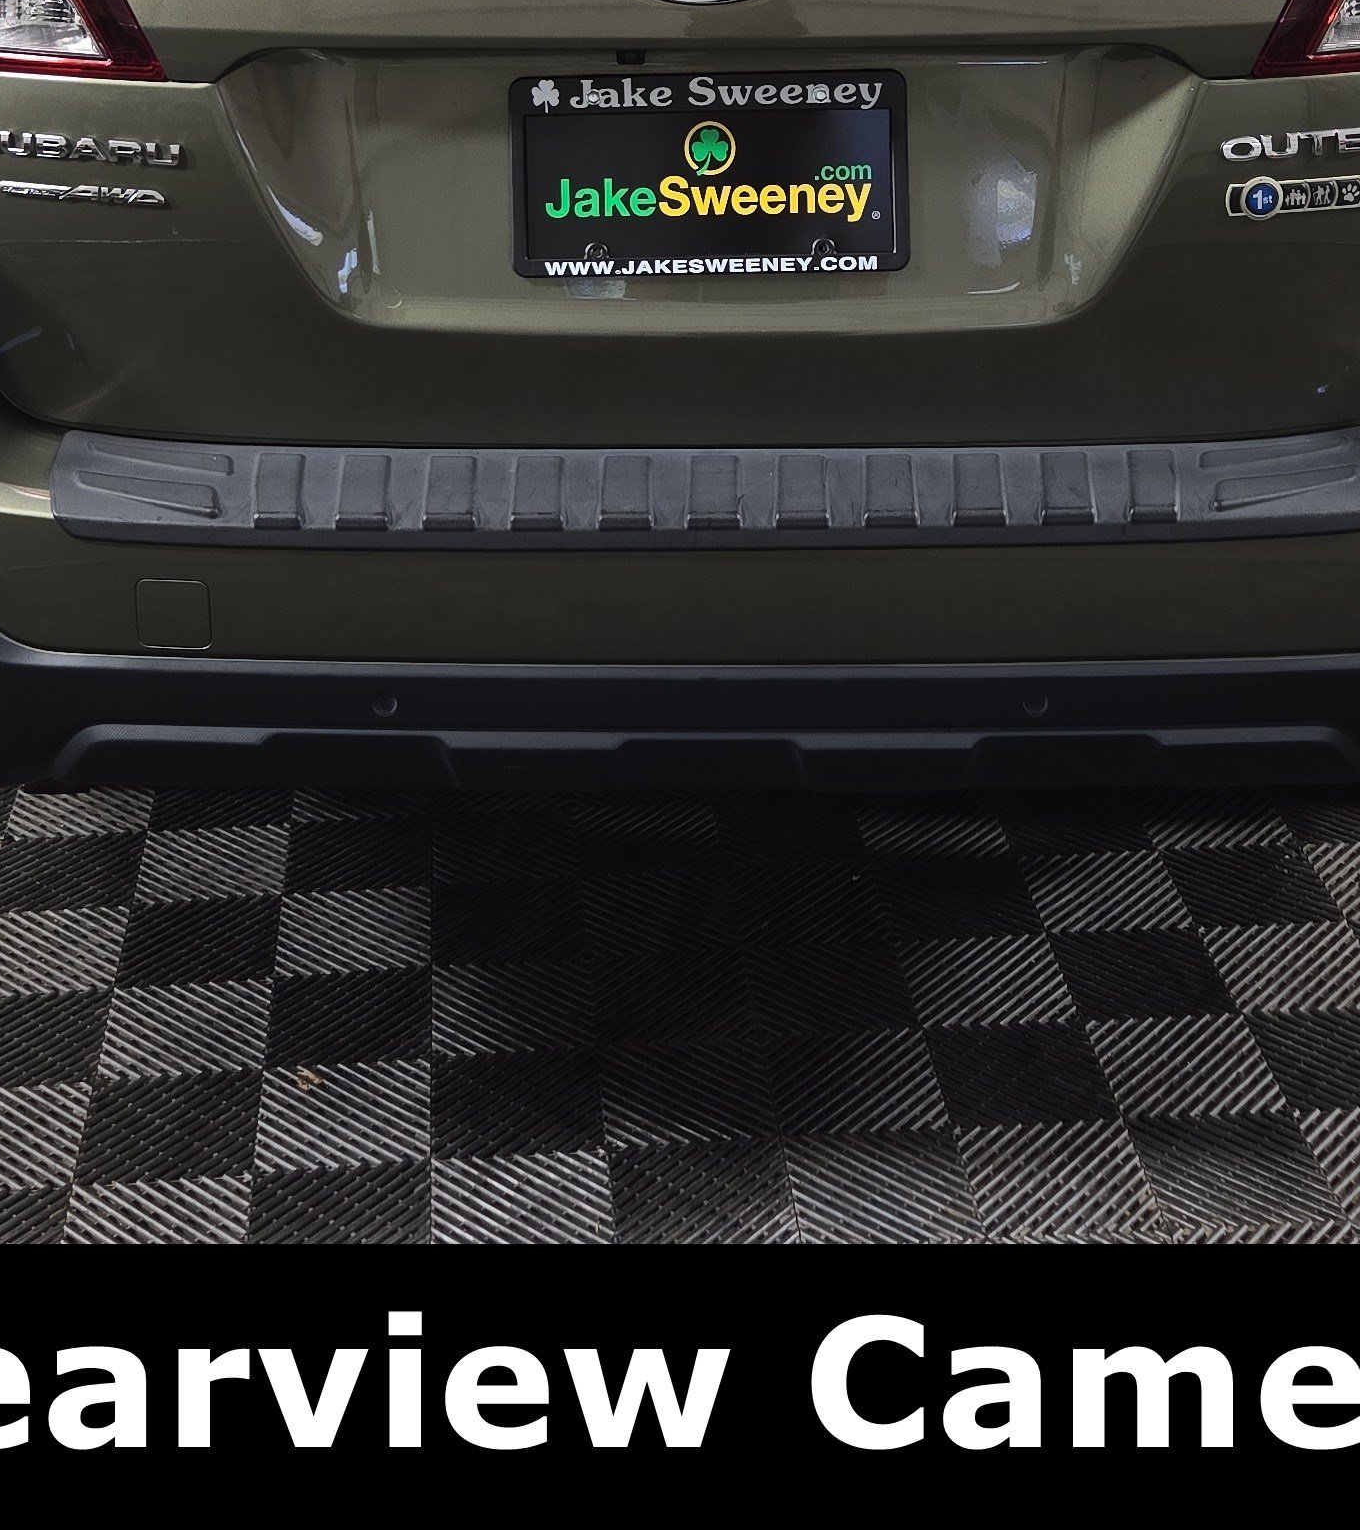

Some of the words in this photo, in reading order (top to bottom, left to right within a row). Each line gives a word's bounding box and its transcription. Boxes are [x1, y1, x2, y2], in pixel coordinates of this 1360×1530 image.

[569, 77, 673, 109] Jake
[687, 76, 883, 110] Sweeney
[814, 163, 873, 182] .com
[58, 184, 166, 205] AWD
[545, 175, 873, 223] JakeSweeney
[1252, 189, 1274, 210] 1st
[544, 255, 879, 276] WWW.JAKESWEENEY.COM
